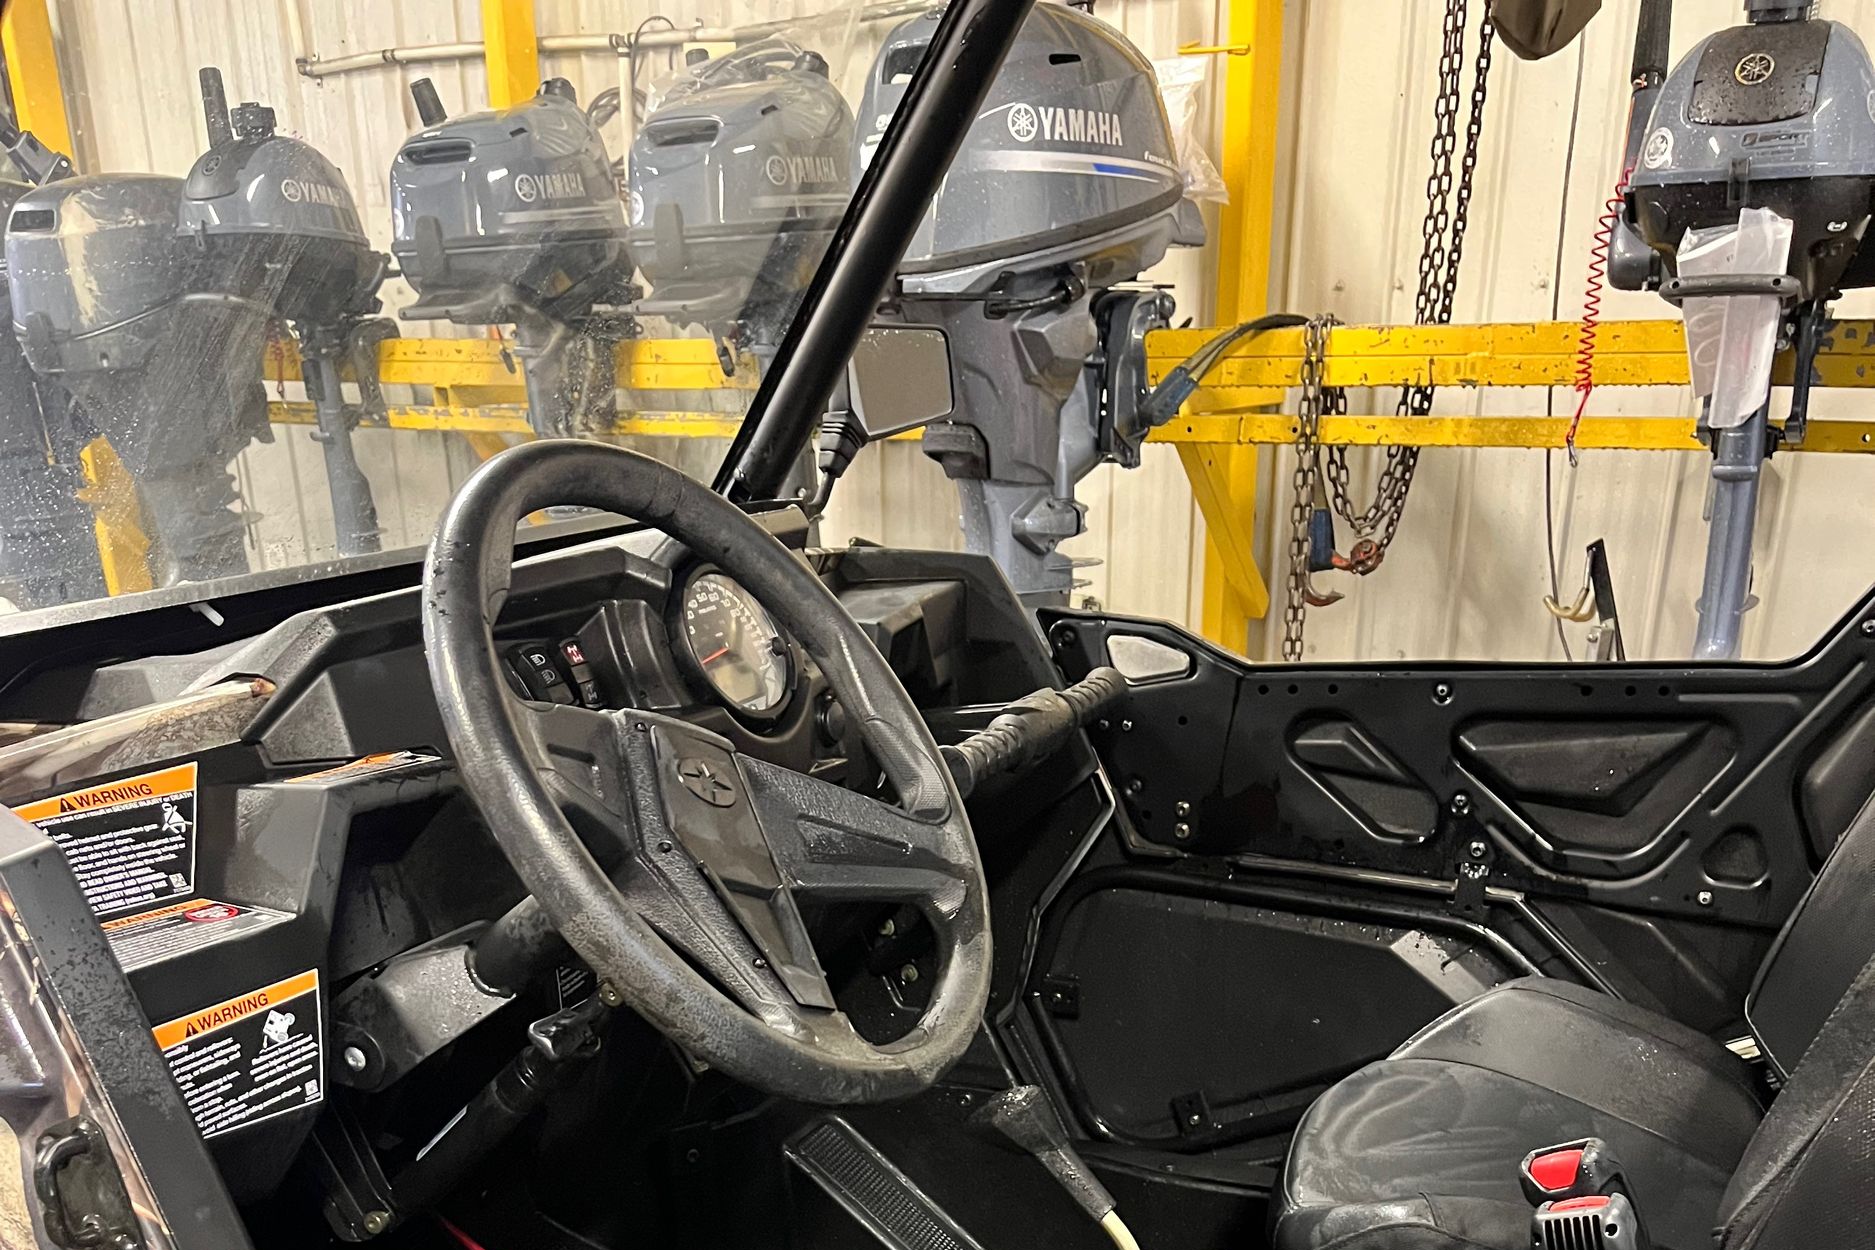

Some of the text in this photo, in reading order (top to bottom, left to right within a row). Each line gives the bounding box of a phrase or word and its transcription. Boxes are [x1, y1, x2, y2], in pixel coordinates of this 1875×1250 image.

[1038, 106, 1123, 146] YAMAHA
[786, 157, 839, 183] YAMAHA
[534, 172, 587, 199] YAMAHA
[73, 783, 152, 808] WARNING
[108, 904, 187, 928] WARNING
[197, 992, 269, 1032] WARNING
